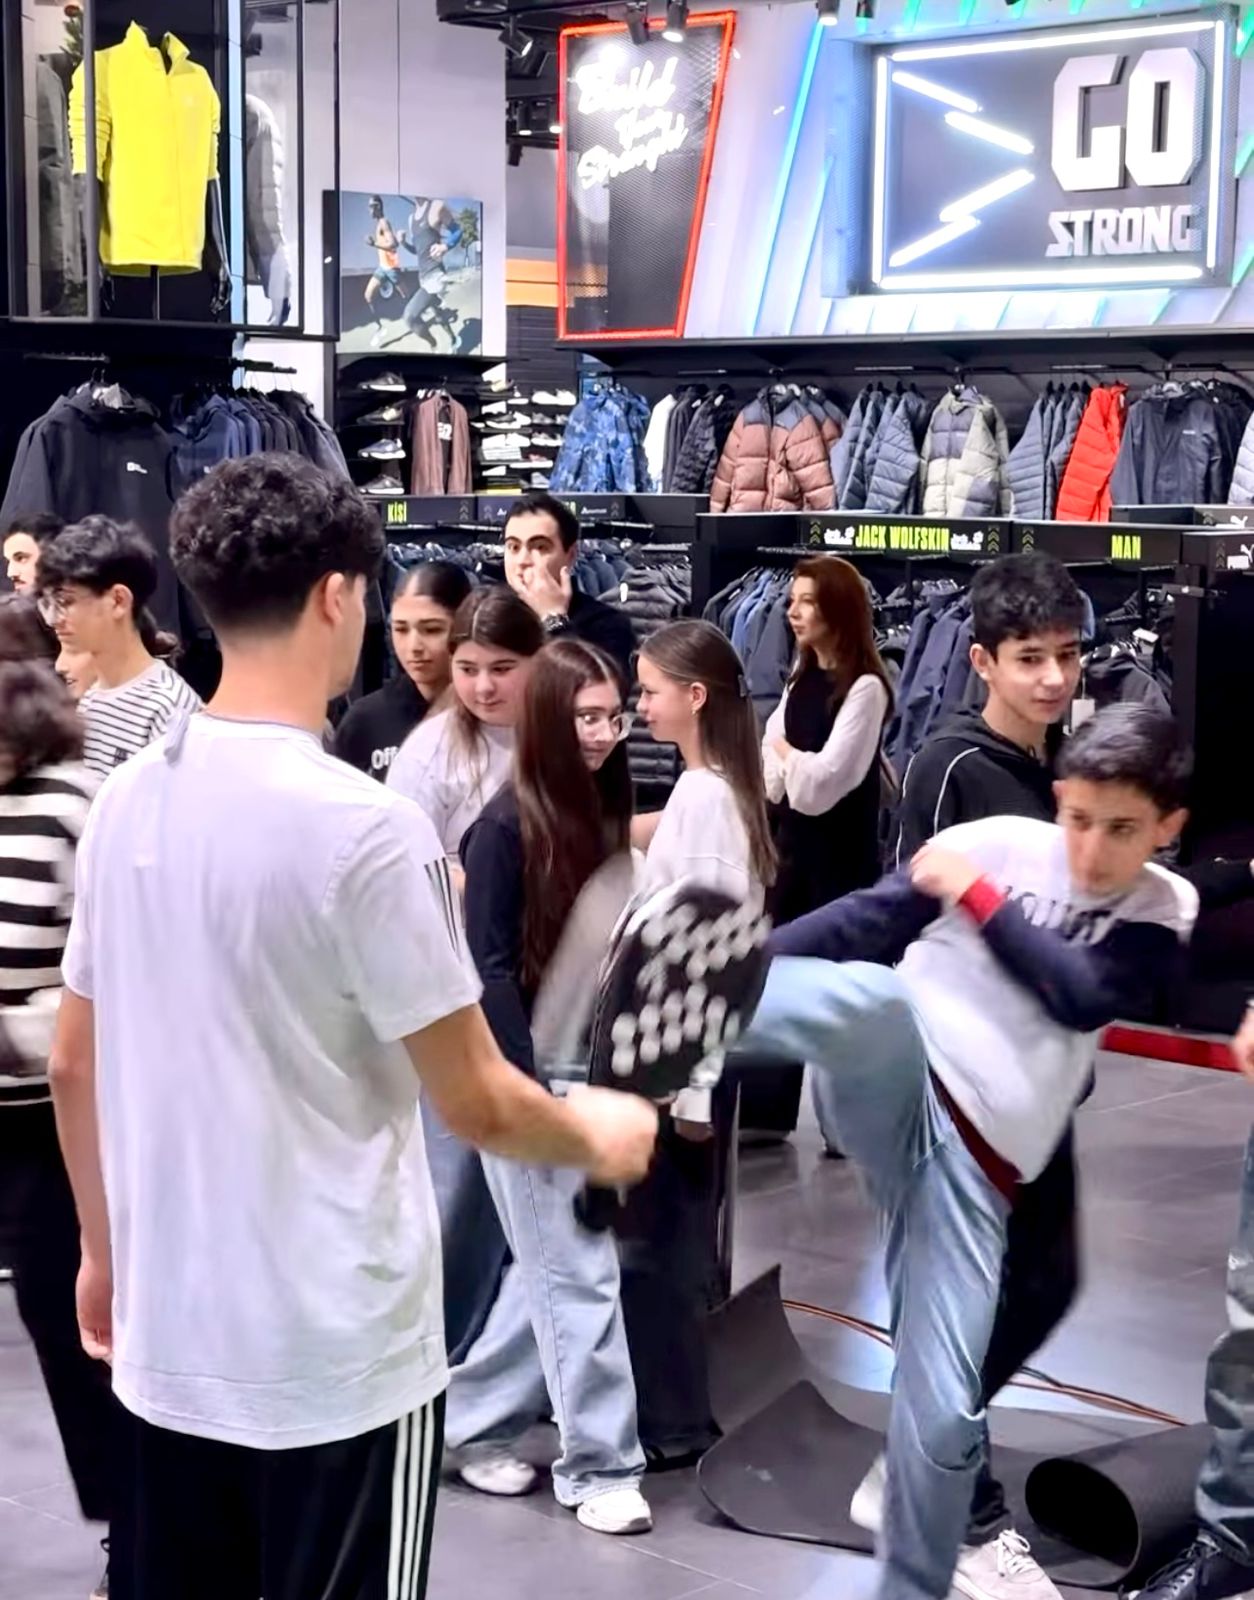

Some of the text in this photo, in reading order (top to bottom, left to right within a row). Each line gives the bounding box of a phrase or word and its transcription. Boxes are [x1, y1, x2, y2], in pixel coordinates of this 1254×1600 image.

[1051, 47, 1202, 192] GO
[1045, 204, 1202, 257] STRONG
[855, 525, 887, 548] JACK
[889, 526, 950, 552] WOLFSKIN
[1111, 534, 1142, 560] MAN
